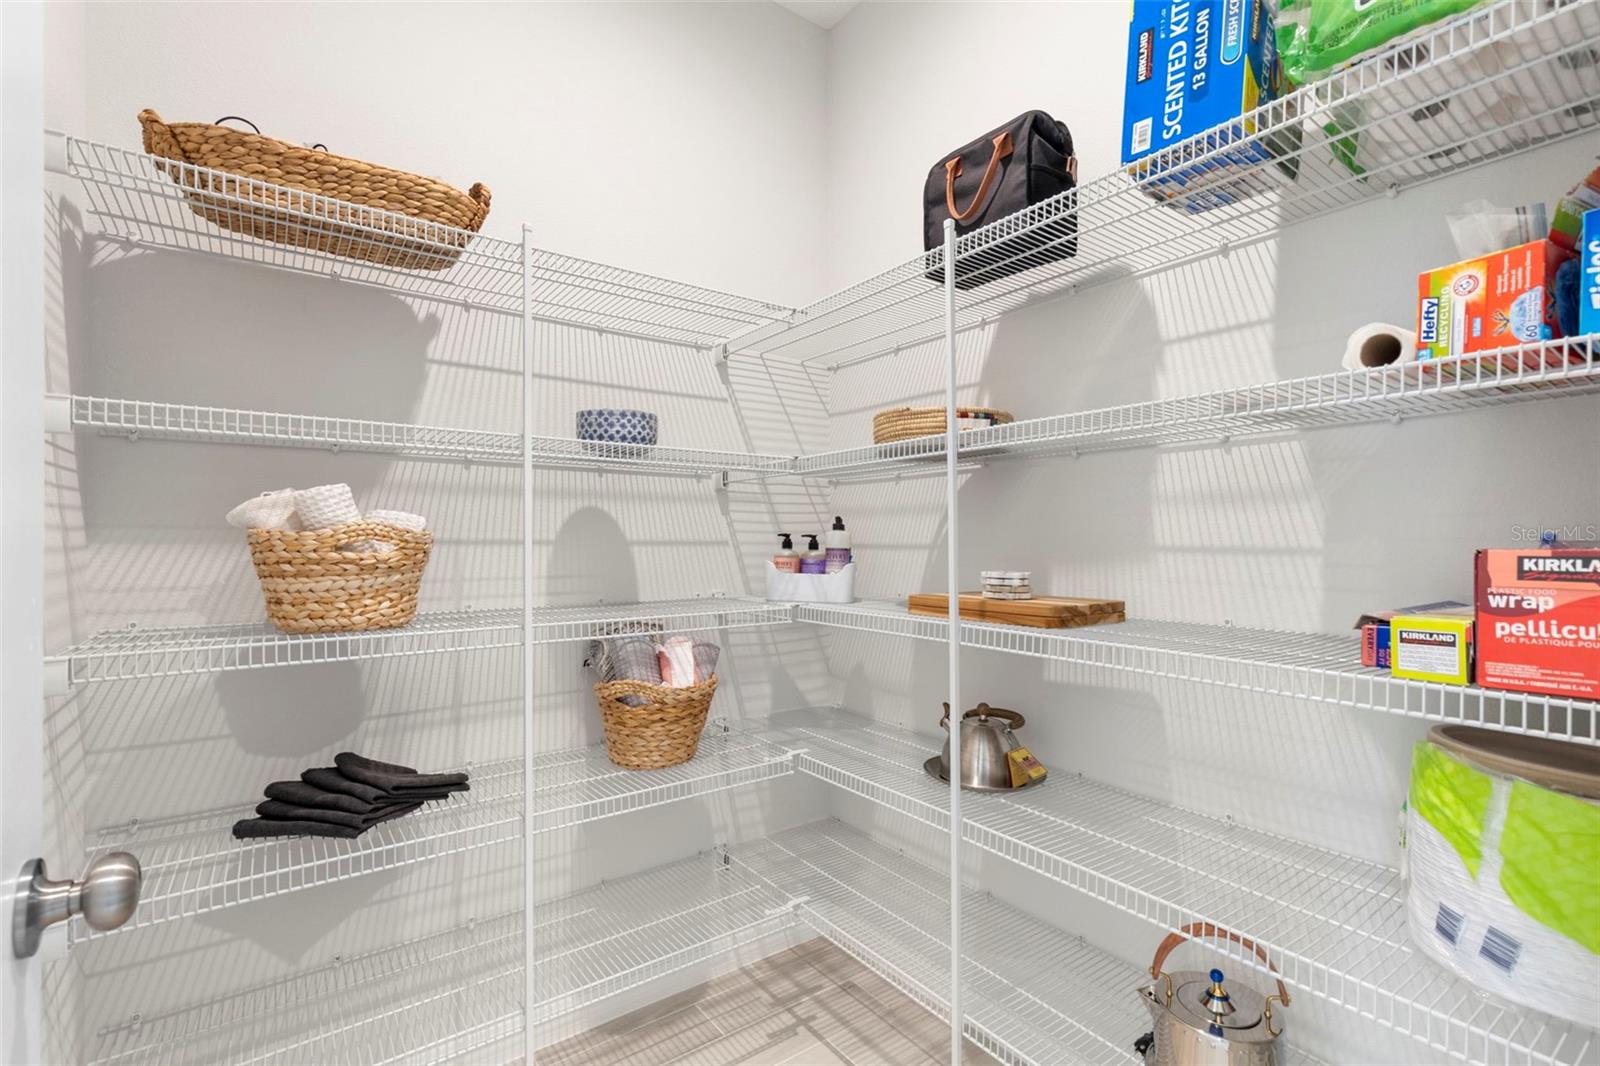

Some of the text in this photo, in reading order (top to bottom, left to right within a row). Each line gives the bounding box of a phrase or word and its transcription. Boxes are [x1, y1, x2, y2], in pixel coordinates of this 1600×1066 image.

[1169, 0, 1191, 39] KIT
[1227, 15, 1239, 47] FRESH
[1137, 31, 1149, 82] KIRKLAND
[1192, 8, 1210, 90] 13 GALLON
[1162, 40, 1188, 140] SCENTED
[1422, 300, 1439, 340] Hefty
[1439, 286, 1450, 348] RECYCLING
[1525, 324, 1538, 337] 60
[1487, 594, 1555, 613] wrap
[1528, 588, 1557, 596] FOOD
[1401, 631, 1455, 642] KIRKLAND
[1504, 636, 1517, 644] DE
[1520, 637, 1575, 648] PLASTIQUE
